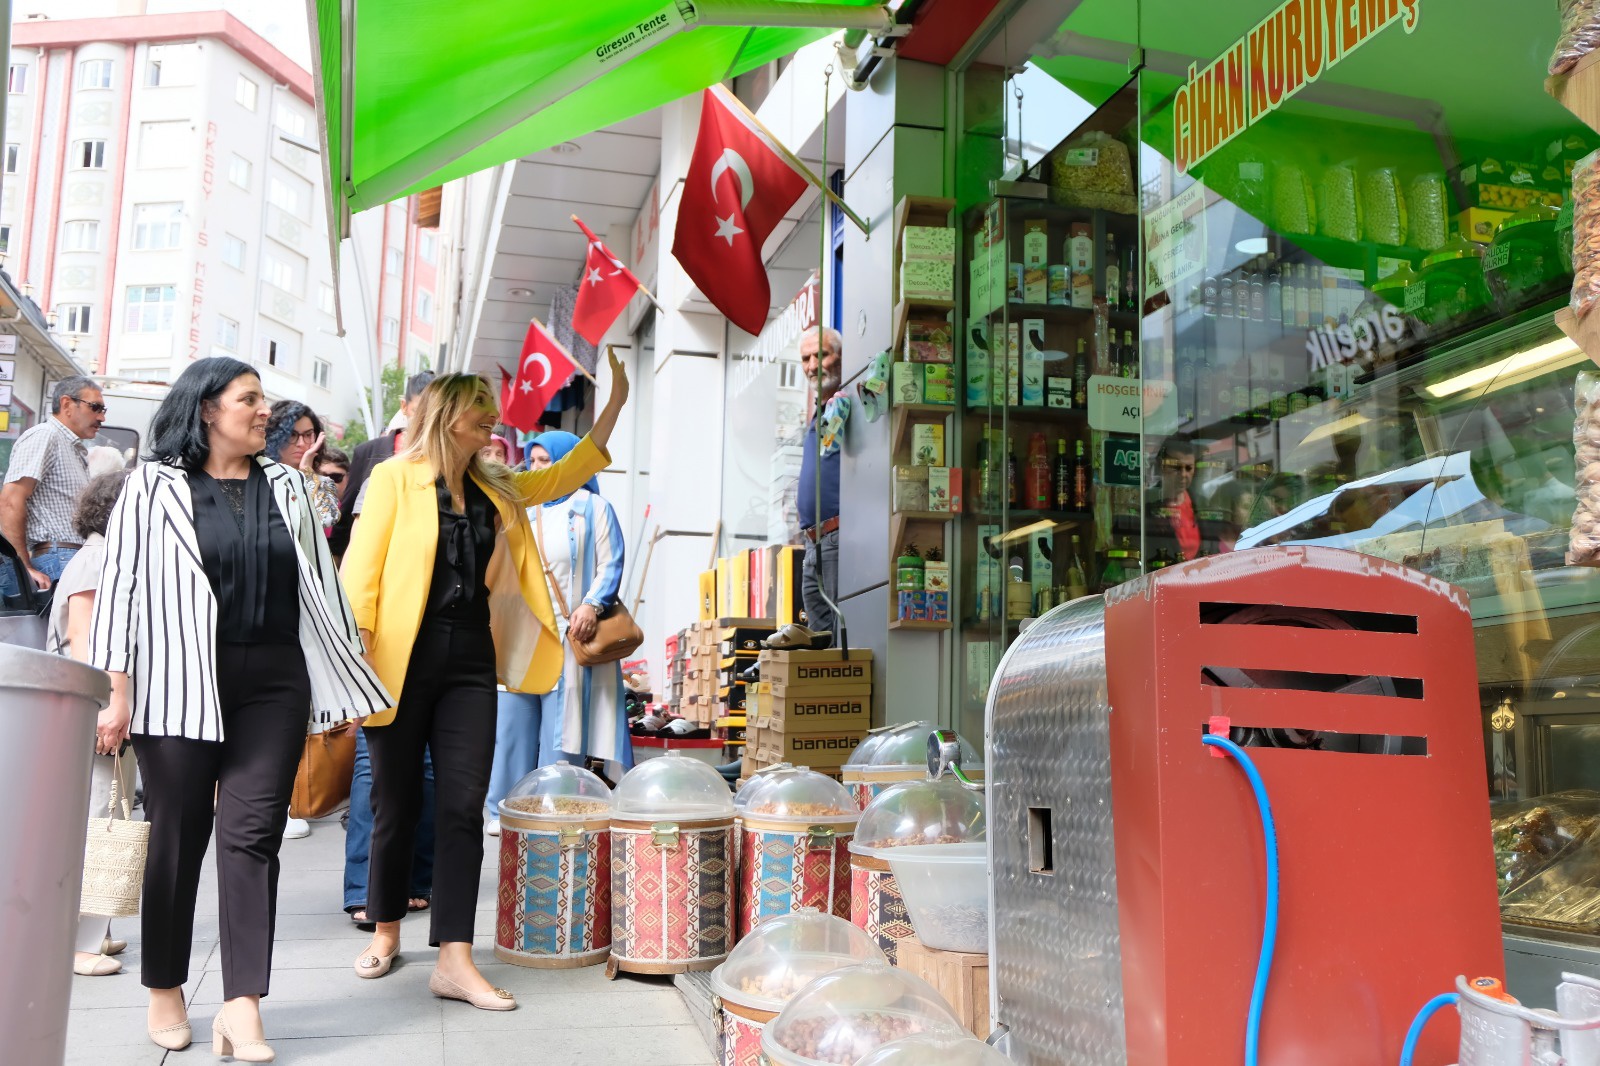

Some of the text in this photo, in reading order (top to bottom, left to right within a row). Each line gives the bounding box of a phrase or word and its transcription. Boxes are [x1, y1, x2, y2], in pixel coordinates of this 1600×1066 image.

[596, 31, 636, 57] Giresun
[636, 13, 667, 35] Tente
[1174, 0, 1419, 177] CİHAN KURUYEM
[761, 284, 815, 369] KUNDURA
[1121, 406, 1141, 419] AÇI
[797, 664, 863, 679] banada
[794, 701, 862, 715] banada
[792, 737, 860, 750] banada
